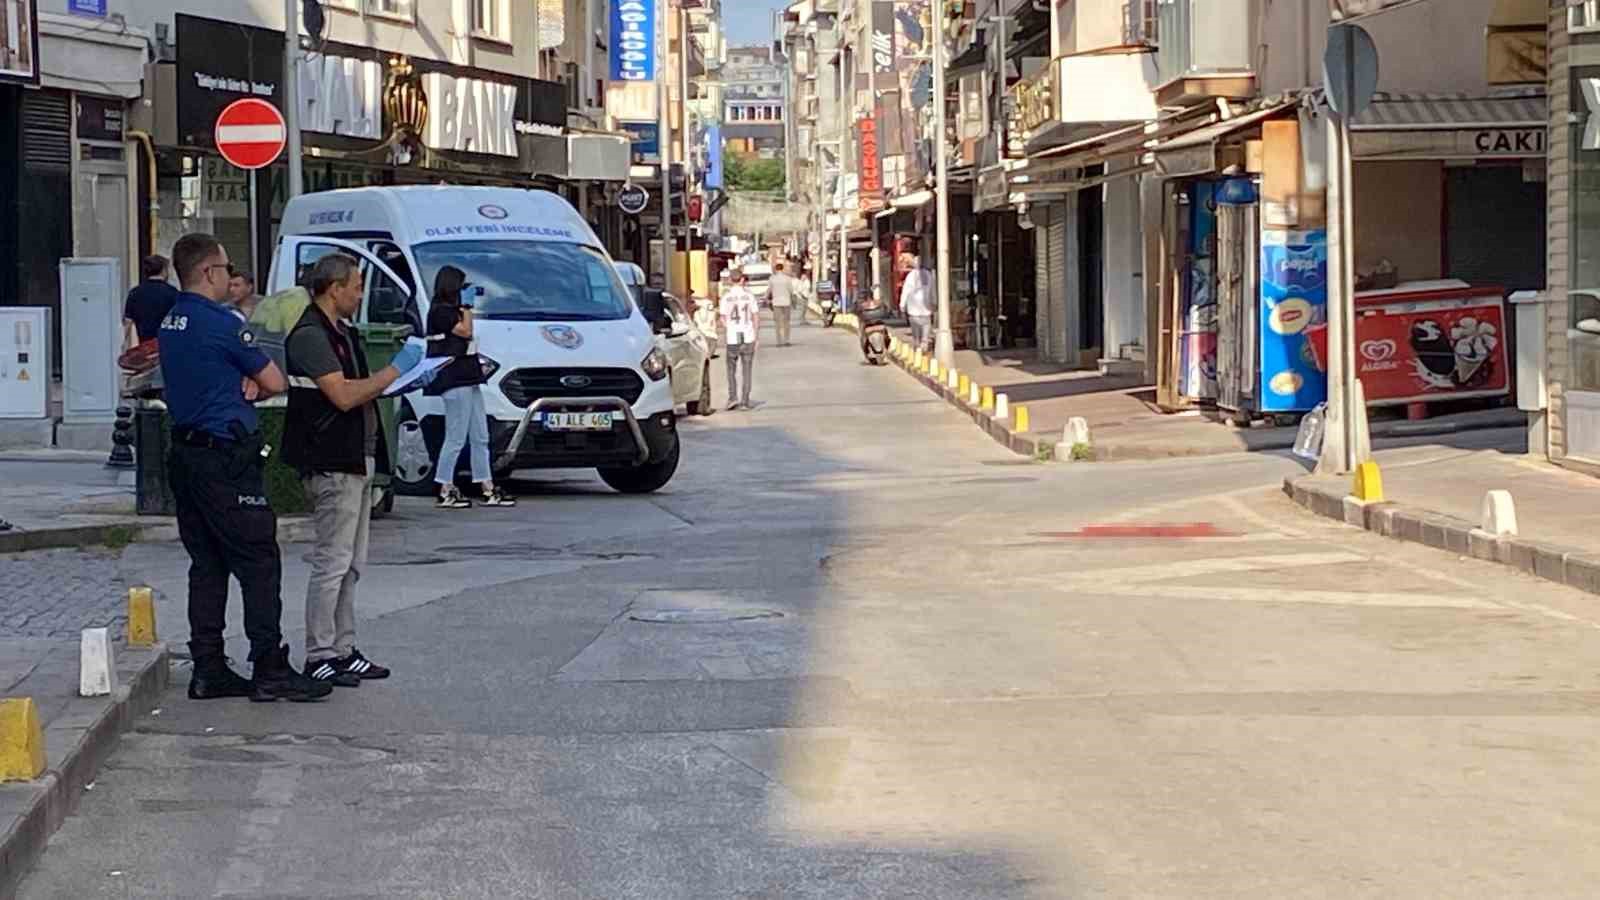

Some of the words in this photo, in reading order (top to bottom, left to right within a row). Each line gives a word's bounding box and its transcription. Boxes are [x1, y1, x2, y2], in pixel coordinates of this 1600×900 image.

[421, 72, 519, 157] BANK
[425, 226, 462, 237] OLAY
[730, 303, 750, 325] 41
